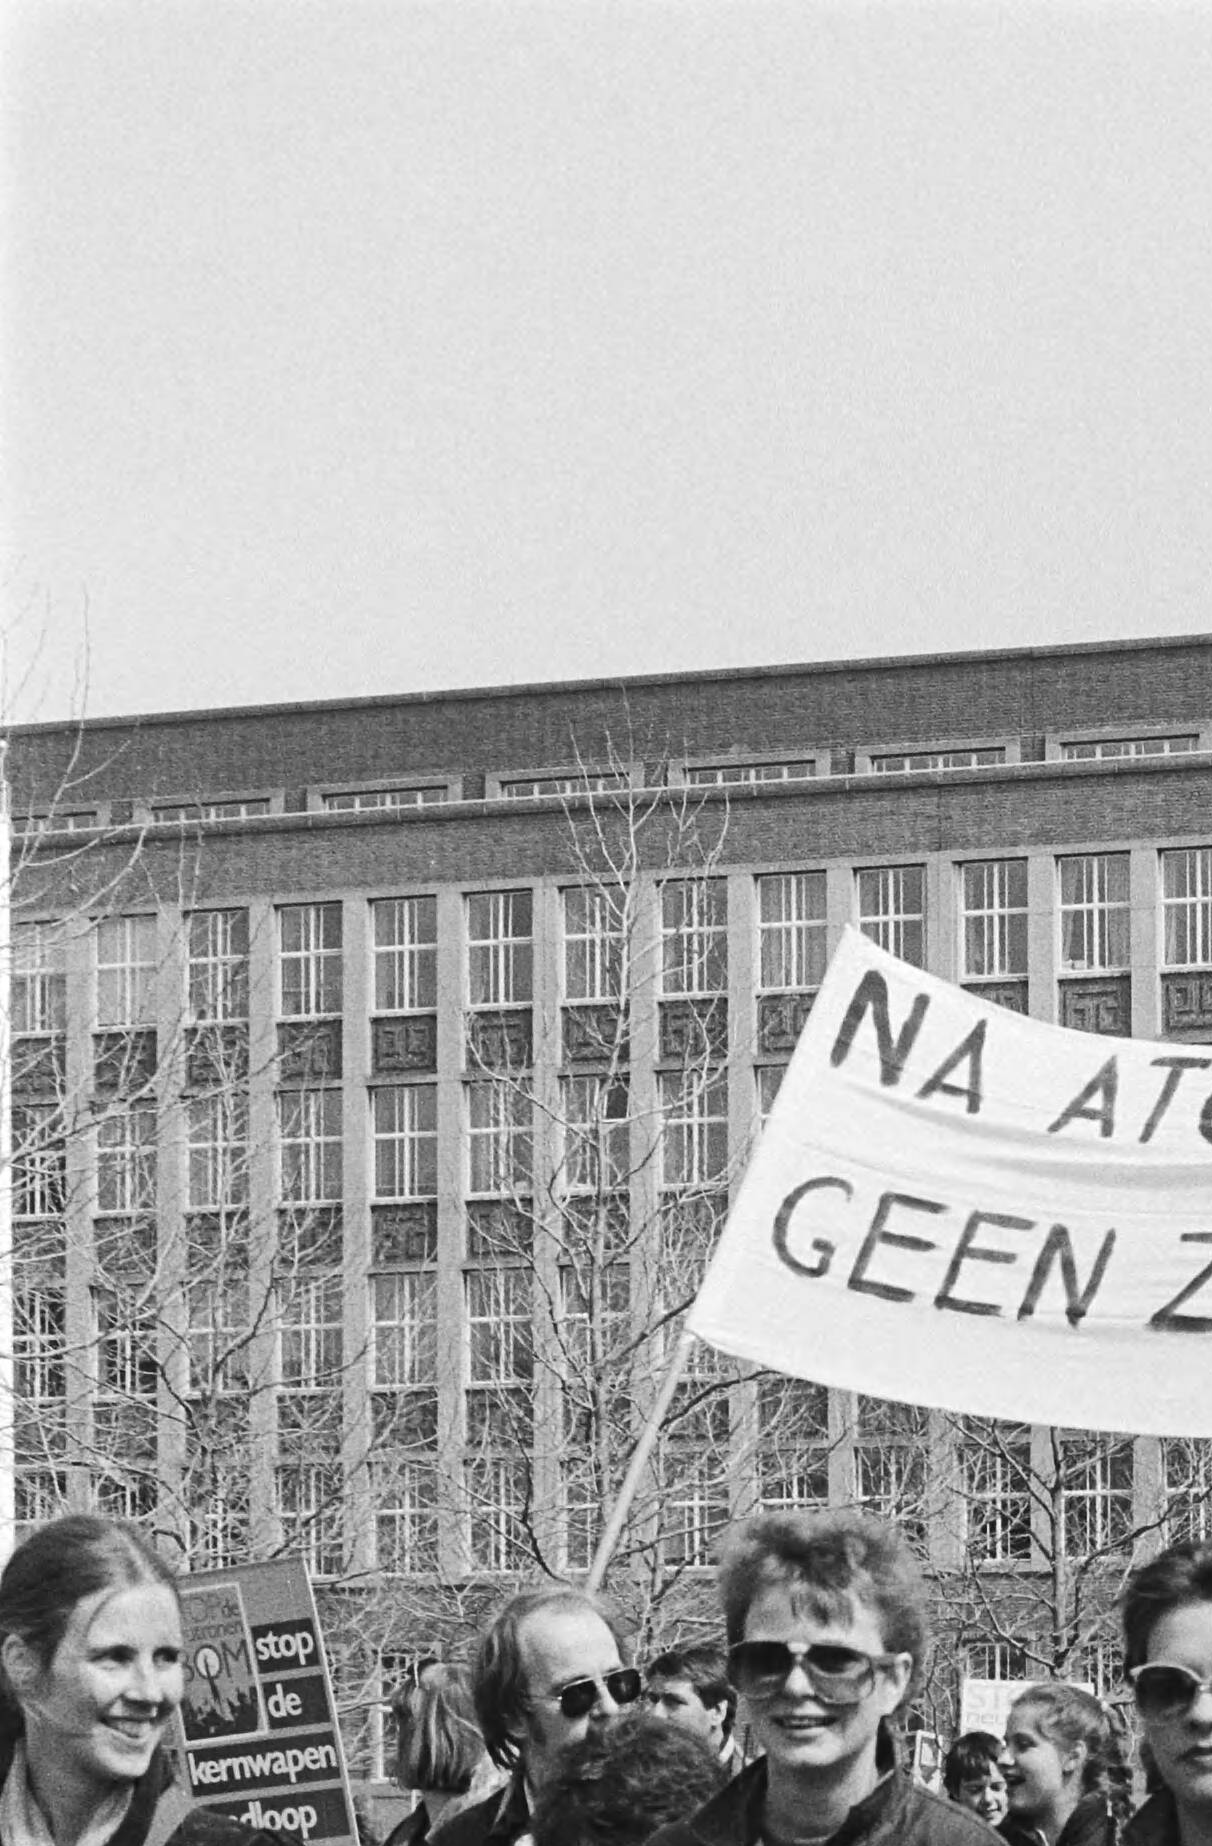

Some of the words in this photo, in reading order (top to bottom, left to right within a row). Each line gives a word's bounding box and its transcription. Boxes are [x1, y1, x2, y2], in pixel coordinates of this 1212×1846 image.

[830, 970, 988, 1116] NA
[771, 1176, 1117, 1331] GEEN
[256, 1631, 314, 1666] stop
[268, 1683, 303, 1718] de
[187, 1745, 338, 1786] kernwapen
[228, 1801, 317, 1840] dloop
